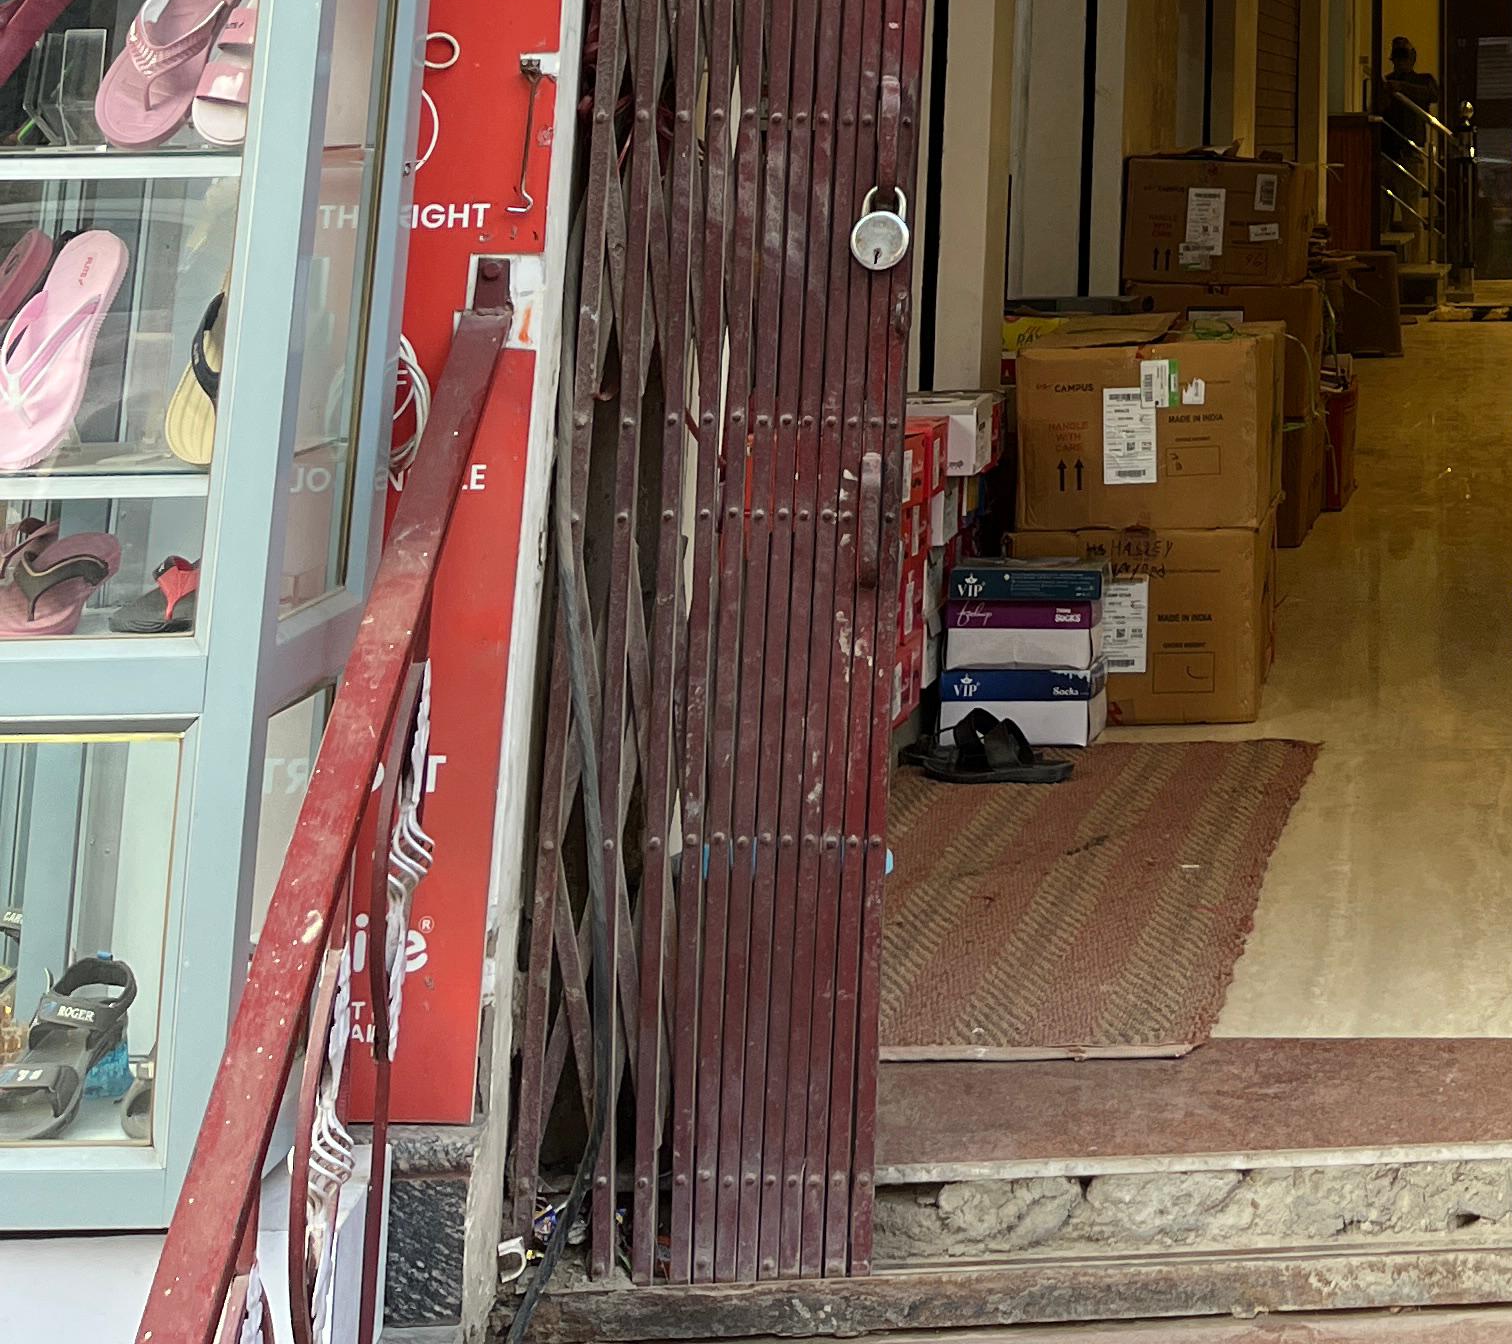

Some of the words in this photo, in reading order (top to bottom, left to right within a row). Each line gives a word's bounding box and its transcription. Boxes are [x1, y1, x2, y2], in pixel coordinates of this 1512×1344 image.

[411, 203, 491, 229] IGHT
[1054, 383, 1094, 393] CAMPUS
[1168, 414, 1191, 424] MADE
[957, 583, 983, 597] VIP
[953, 683, 978, 697] VIP
[1052, 686, 1079, 696] Socks
[57, 1005, 96, 1023] ROGER
